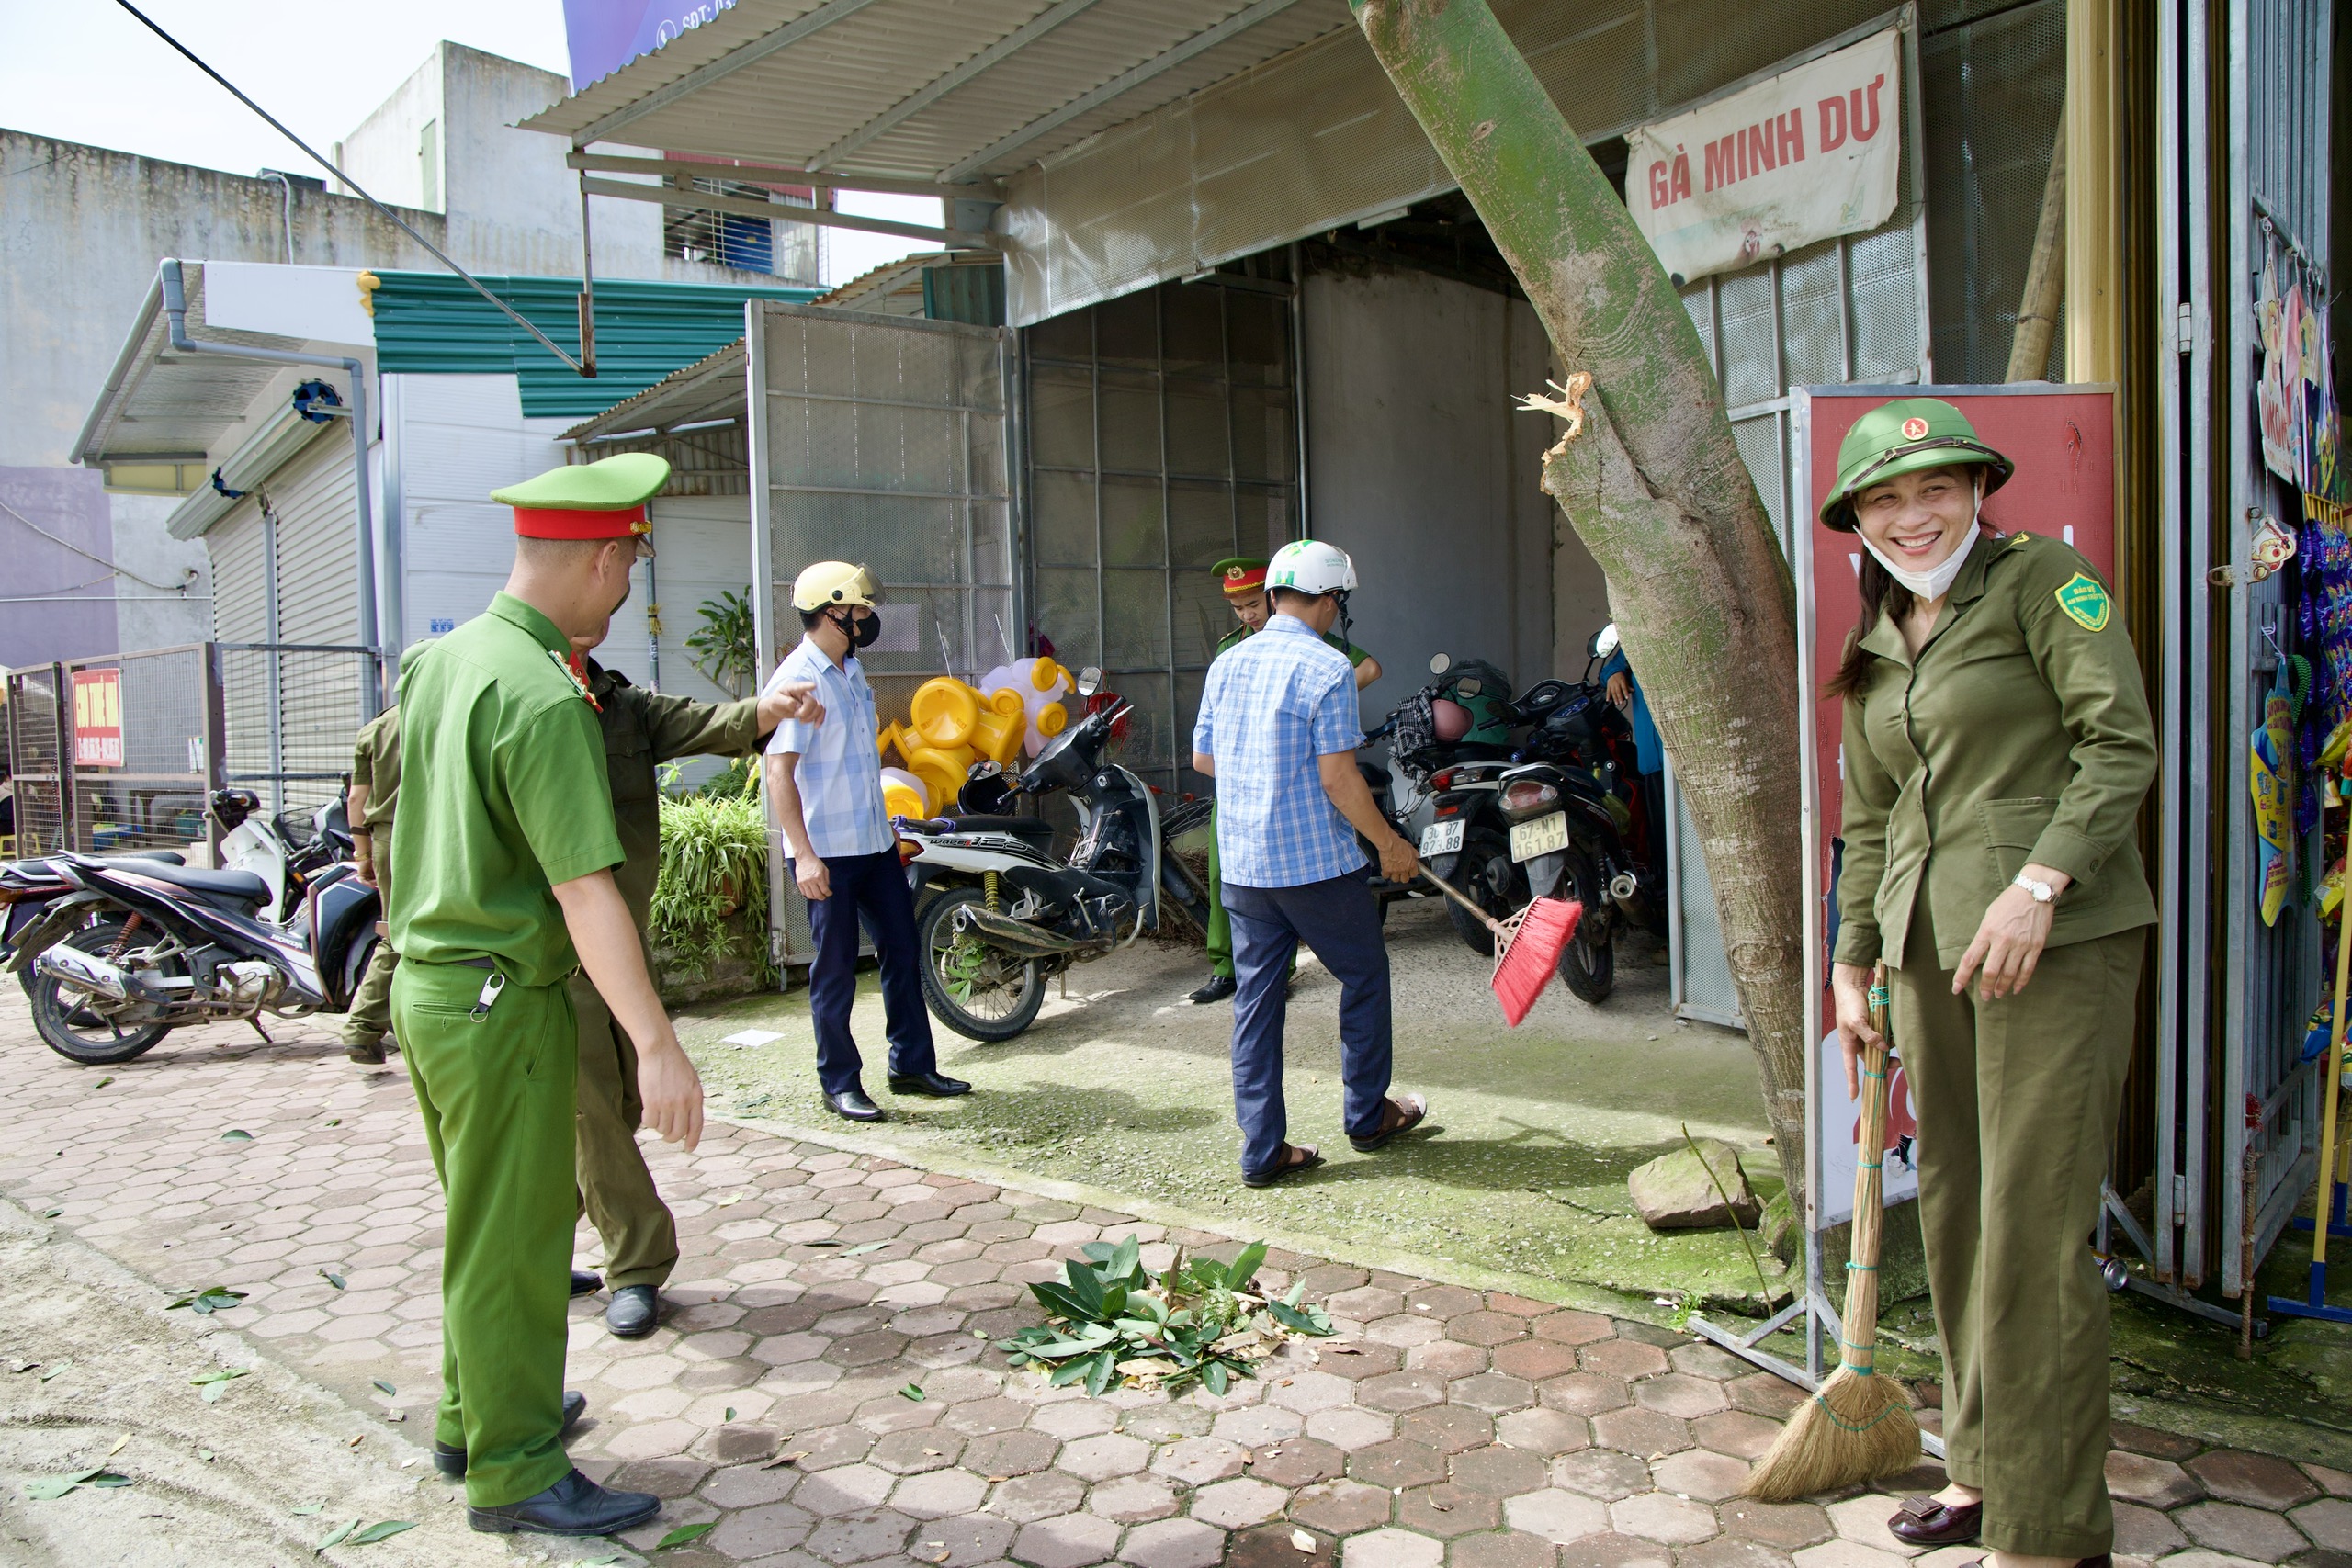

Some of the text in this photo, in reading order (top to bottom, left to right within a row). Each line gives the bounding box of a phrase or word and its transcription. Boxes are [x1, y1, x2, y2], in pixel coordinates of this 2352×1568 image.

[1649, 73, 1884, 210] GÀ MINH DƯ
[1422, 836, 1460, 854] 923.88
[1516, 831, 1565, 858] 161.87
[270, 933, 304, 949] HONDA
